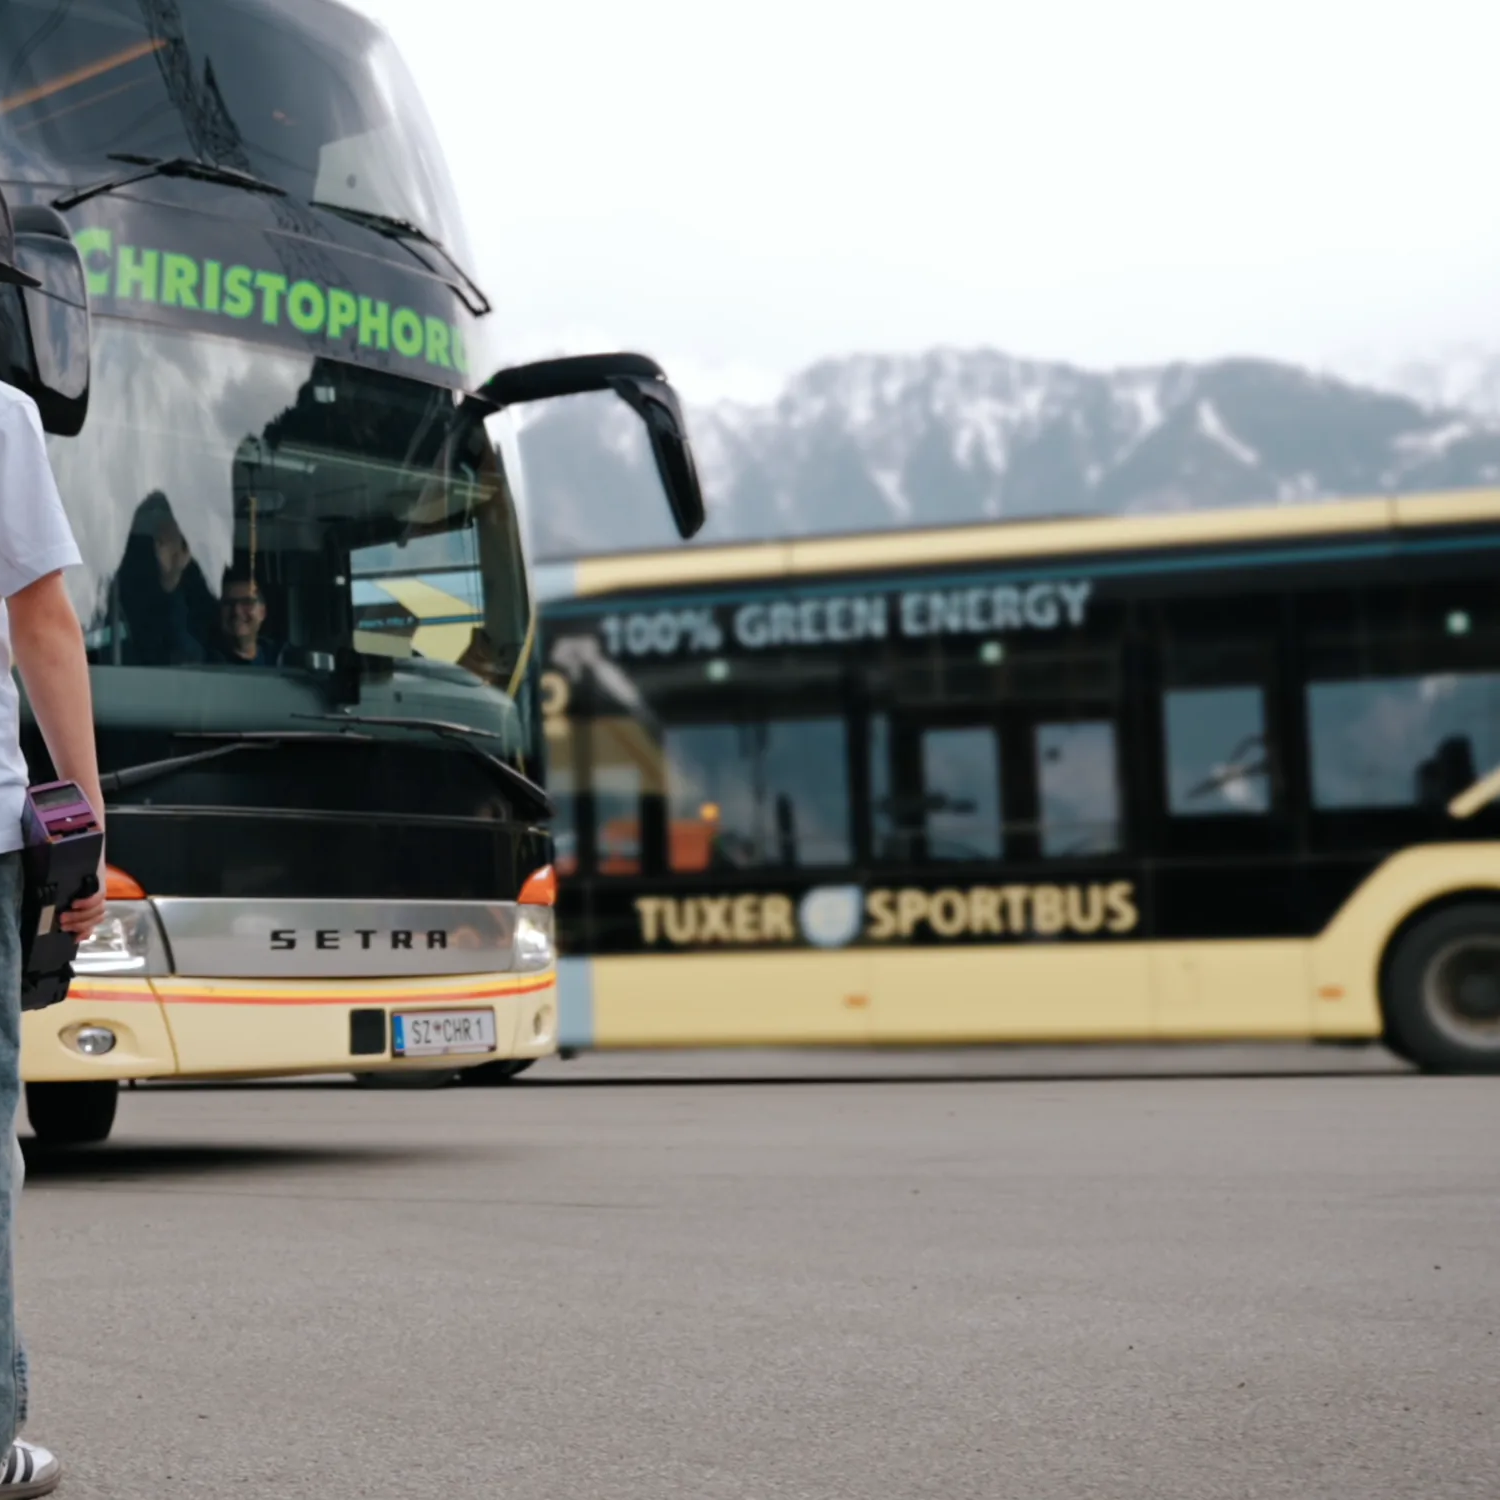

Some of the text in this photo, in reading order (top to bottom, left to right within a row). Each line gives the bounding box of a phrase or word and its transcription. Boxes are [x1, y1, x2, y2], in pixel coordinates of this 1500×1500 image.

[603, 581, 1091, 655] 100% GREEN ENERGY
[270, 929, 447, 950] SETRA
[635, 881, 1138, 945] TUXER SPORTBUS
